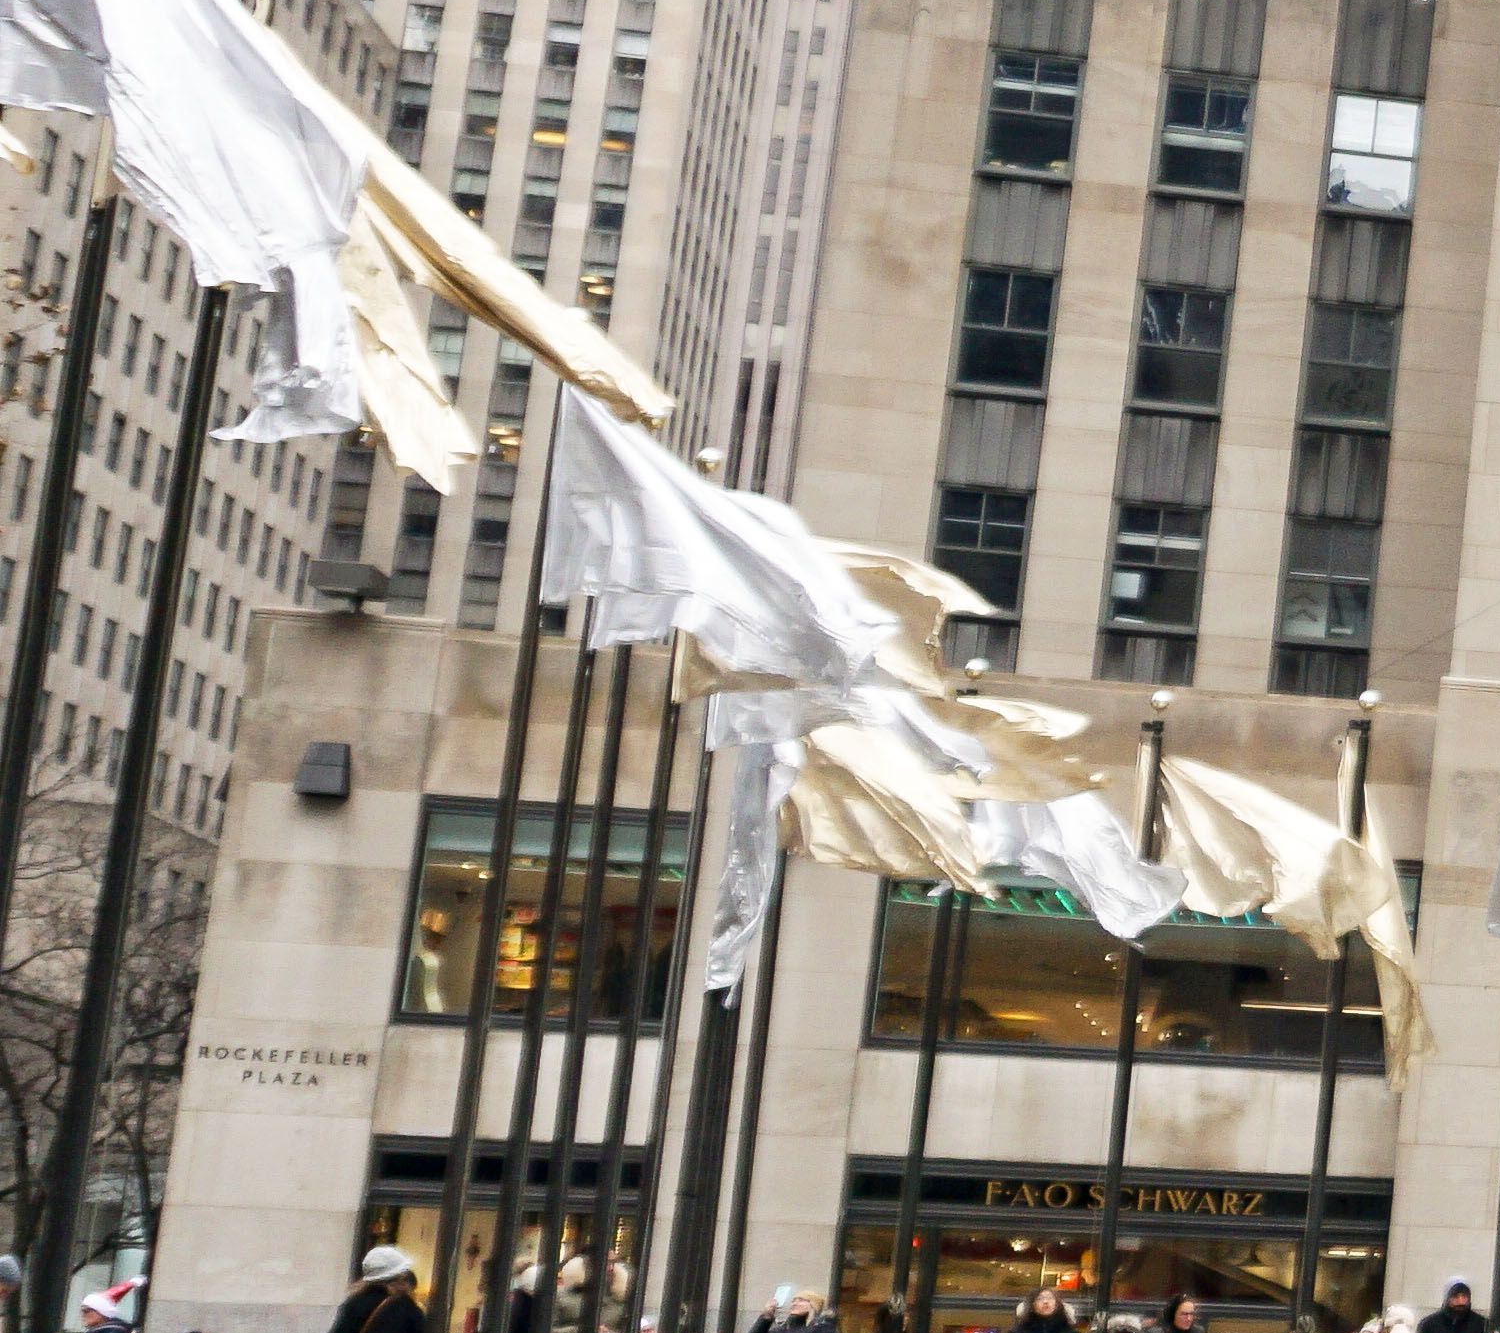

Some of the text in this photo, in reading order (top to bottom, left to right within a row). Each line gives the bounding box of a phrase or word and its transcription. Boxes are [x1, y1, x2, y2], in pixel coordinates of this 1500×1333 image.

[198, 1045, 369, 1067] ROCKEFELLER
[242, 1070, 320, 1086] PLAZA
[1087, 1185, 1264, 1216] SCHWARZ
